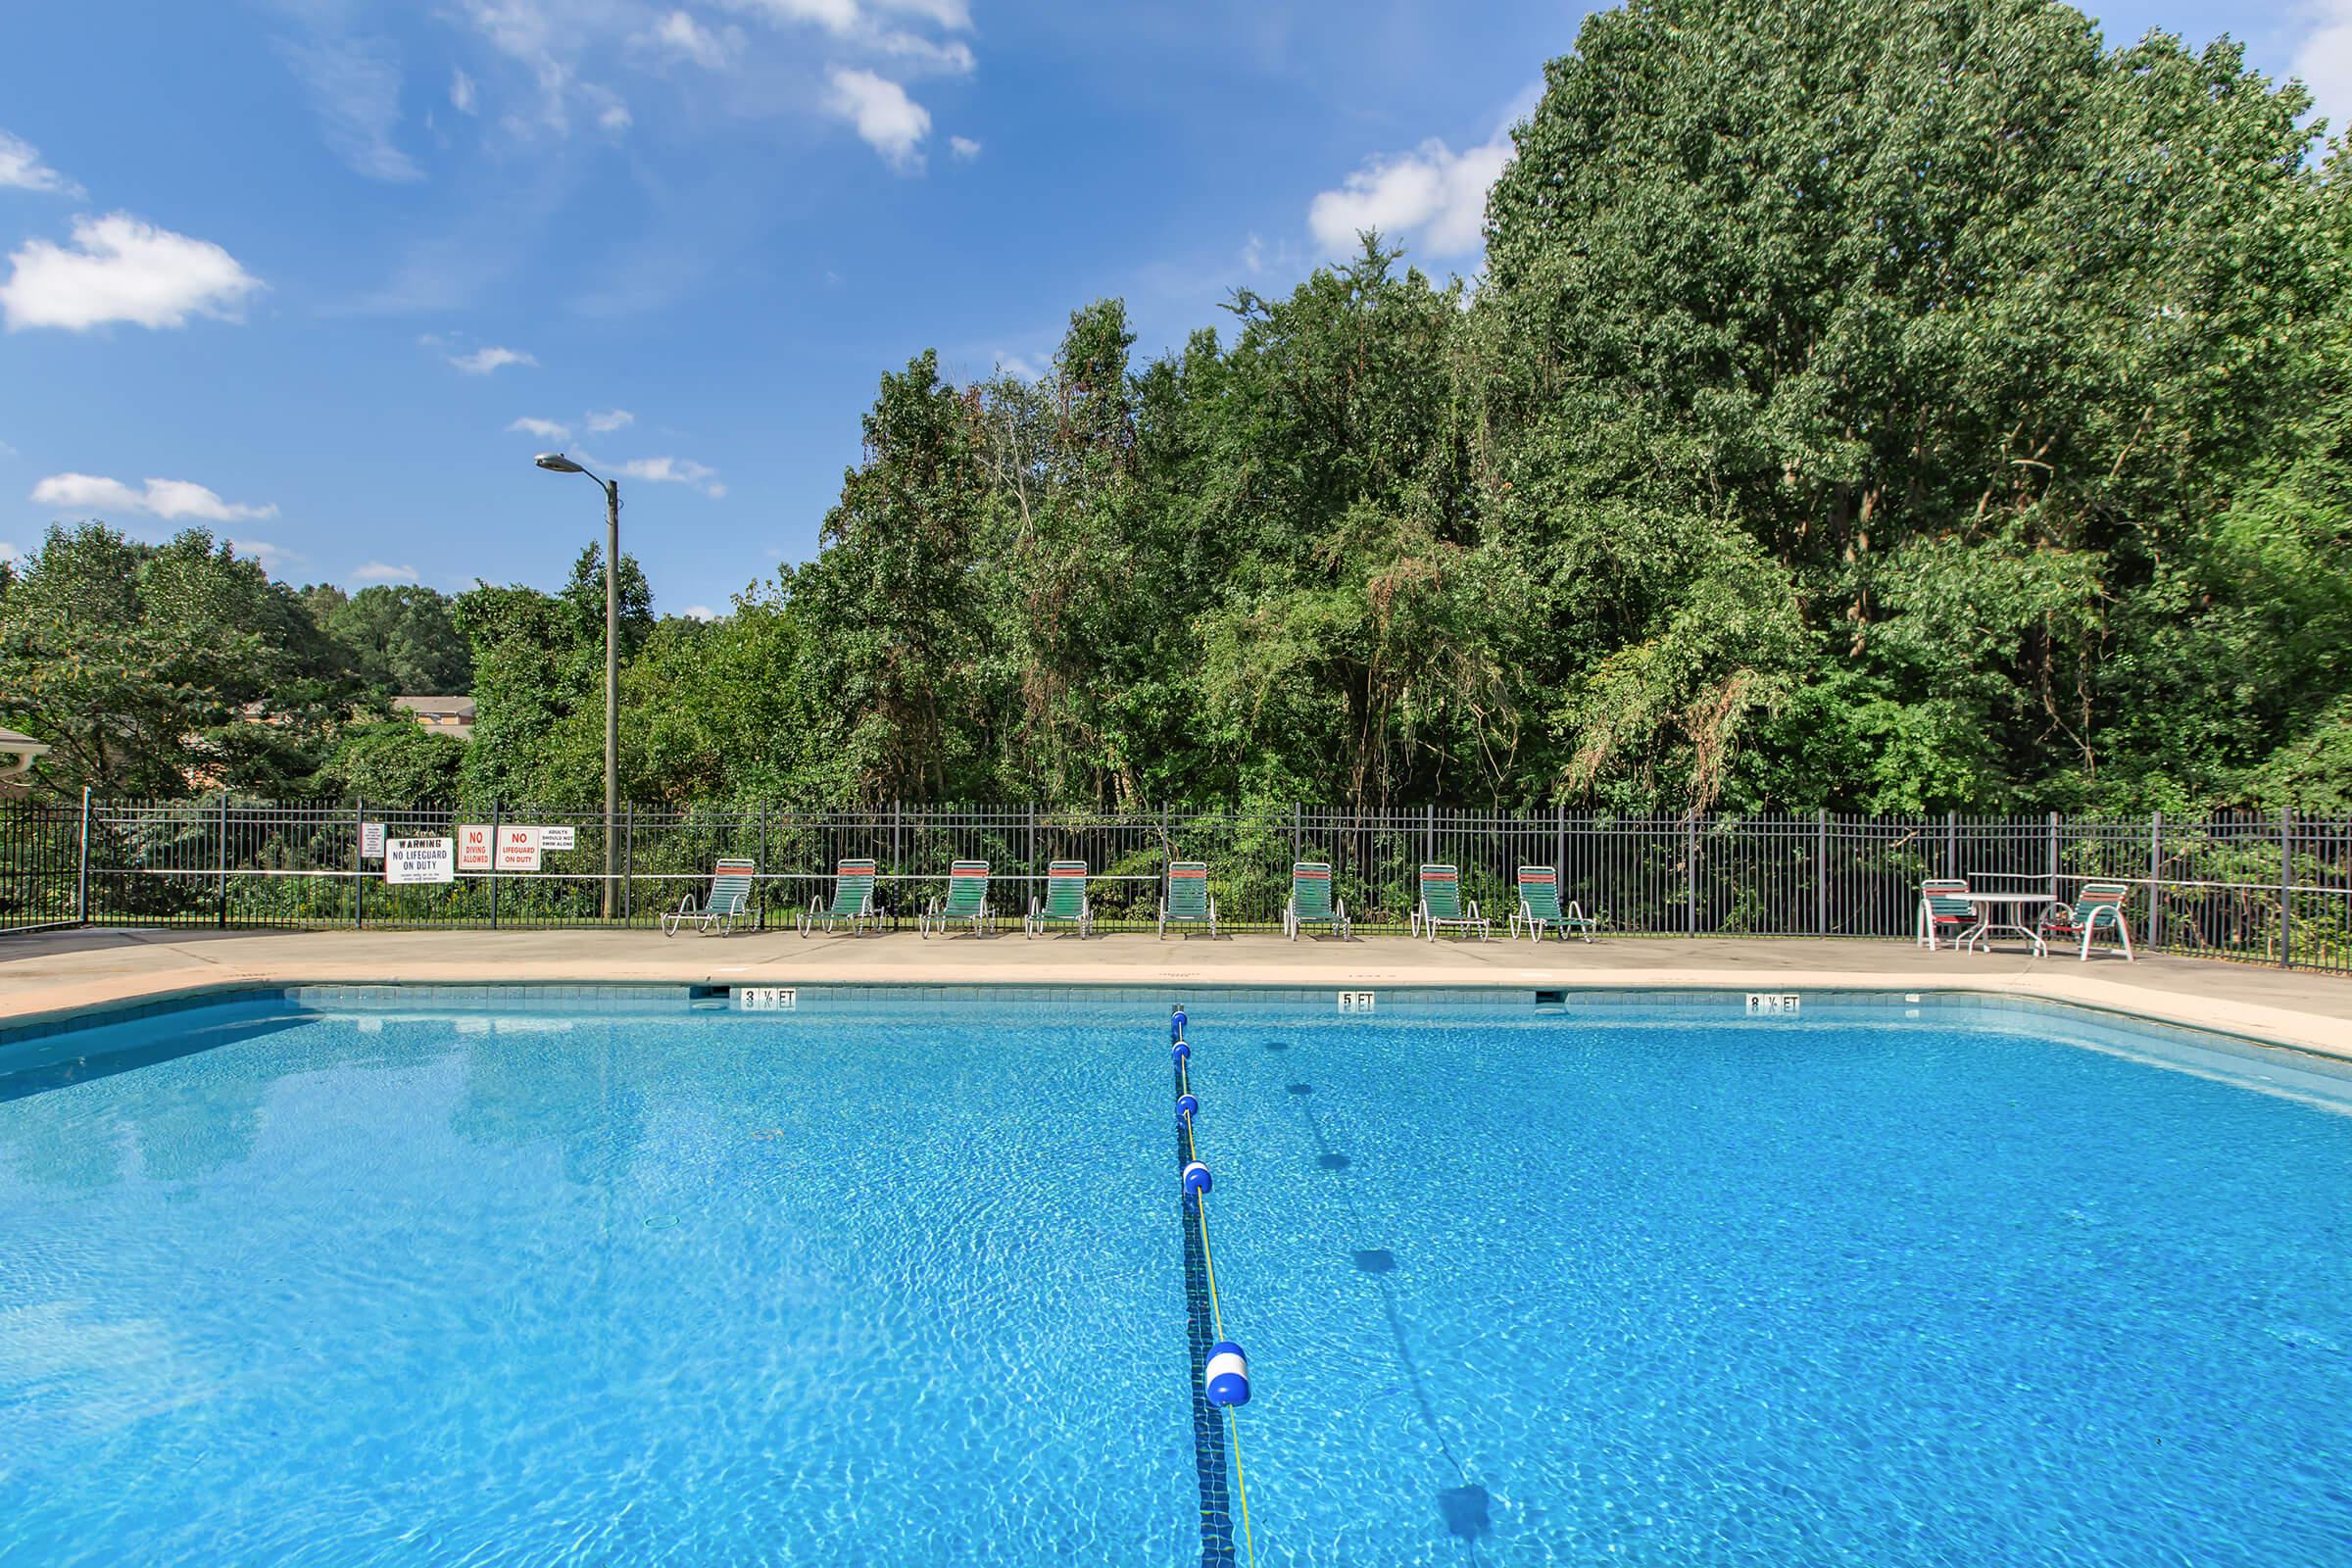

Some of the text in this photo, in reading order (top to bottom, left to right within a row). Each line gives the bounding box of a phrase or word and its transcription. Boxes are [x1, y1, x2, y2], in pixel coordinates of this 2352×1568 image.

[469, 831, 483, 844] NO
[512, 833, 527, 844] NO
[399, 839, 442, 849] WARNING
[392, 850, 447, 860] NO LIFEGUARD
[463, 855, 489, 863] ALLOWED
[403, 861, 437, 870] ON DUTY
[746, 990, 754, 1002] 3
[1344, 994, 1373, 1004] 5 FT
[1751, 997, 1759, 1006] 8
